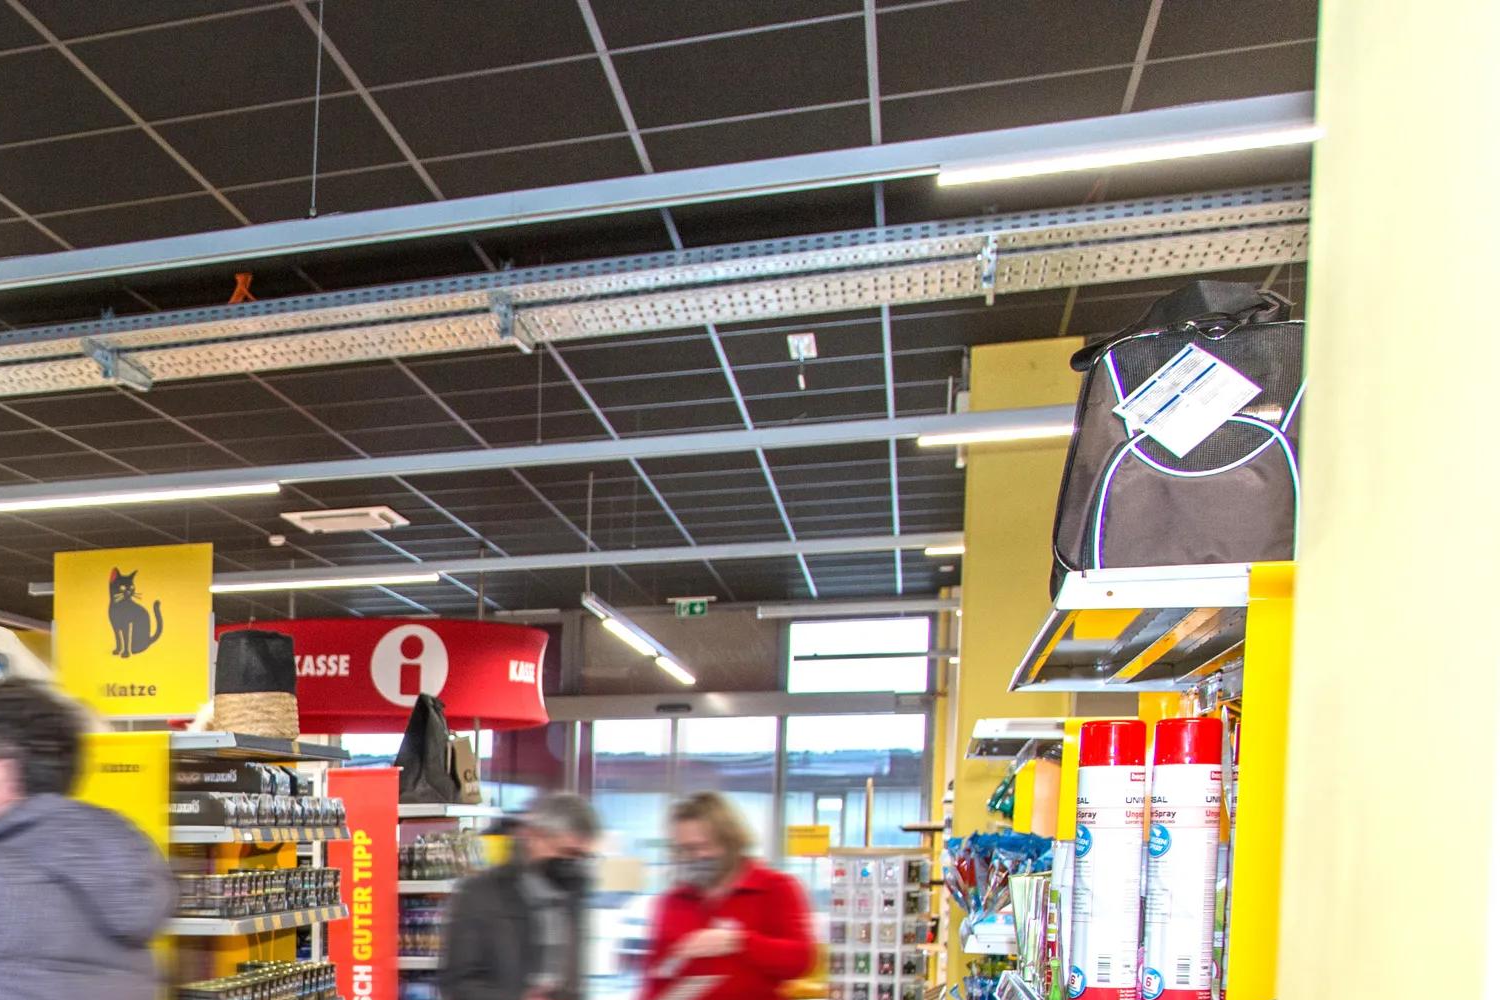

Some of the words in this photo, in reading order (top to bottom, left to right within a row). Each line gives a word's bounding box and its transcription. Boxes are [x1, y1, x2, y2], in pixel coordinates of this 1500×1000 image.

[508, 660, 536, 685] KASSE
[105, 683, 157, 697] Katze
[352, 829, 373, 882] TIPP
[352, 886, 373, 961] GUTER
[1145, 977, 1152, 987] 6
